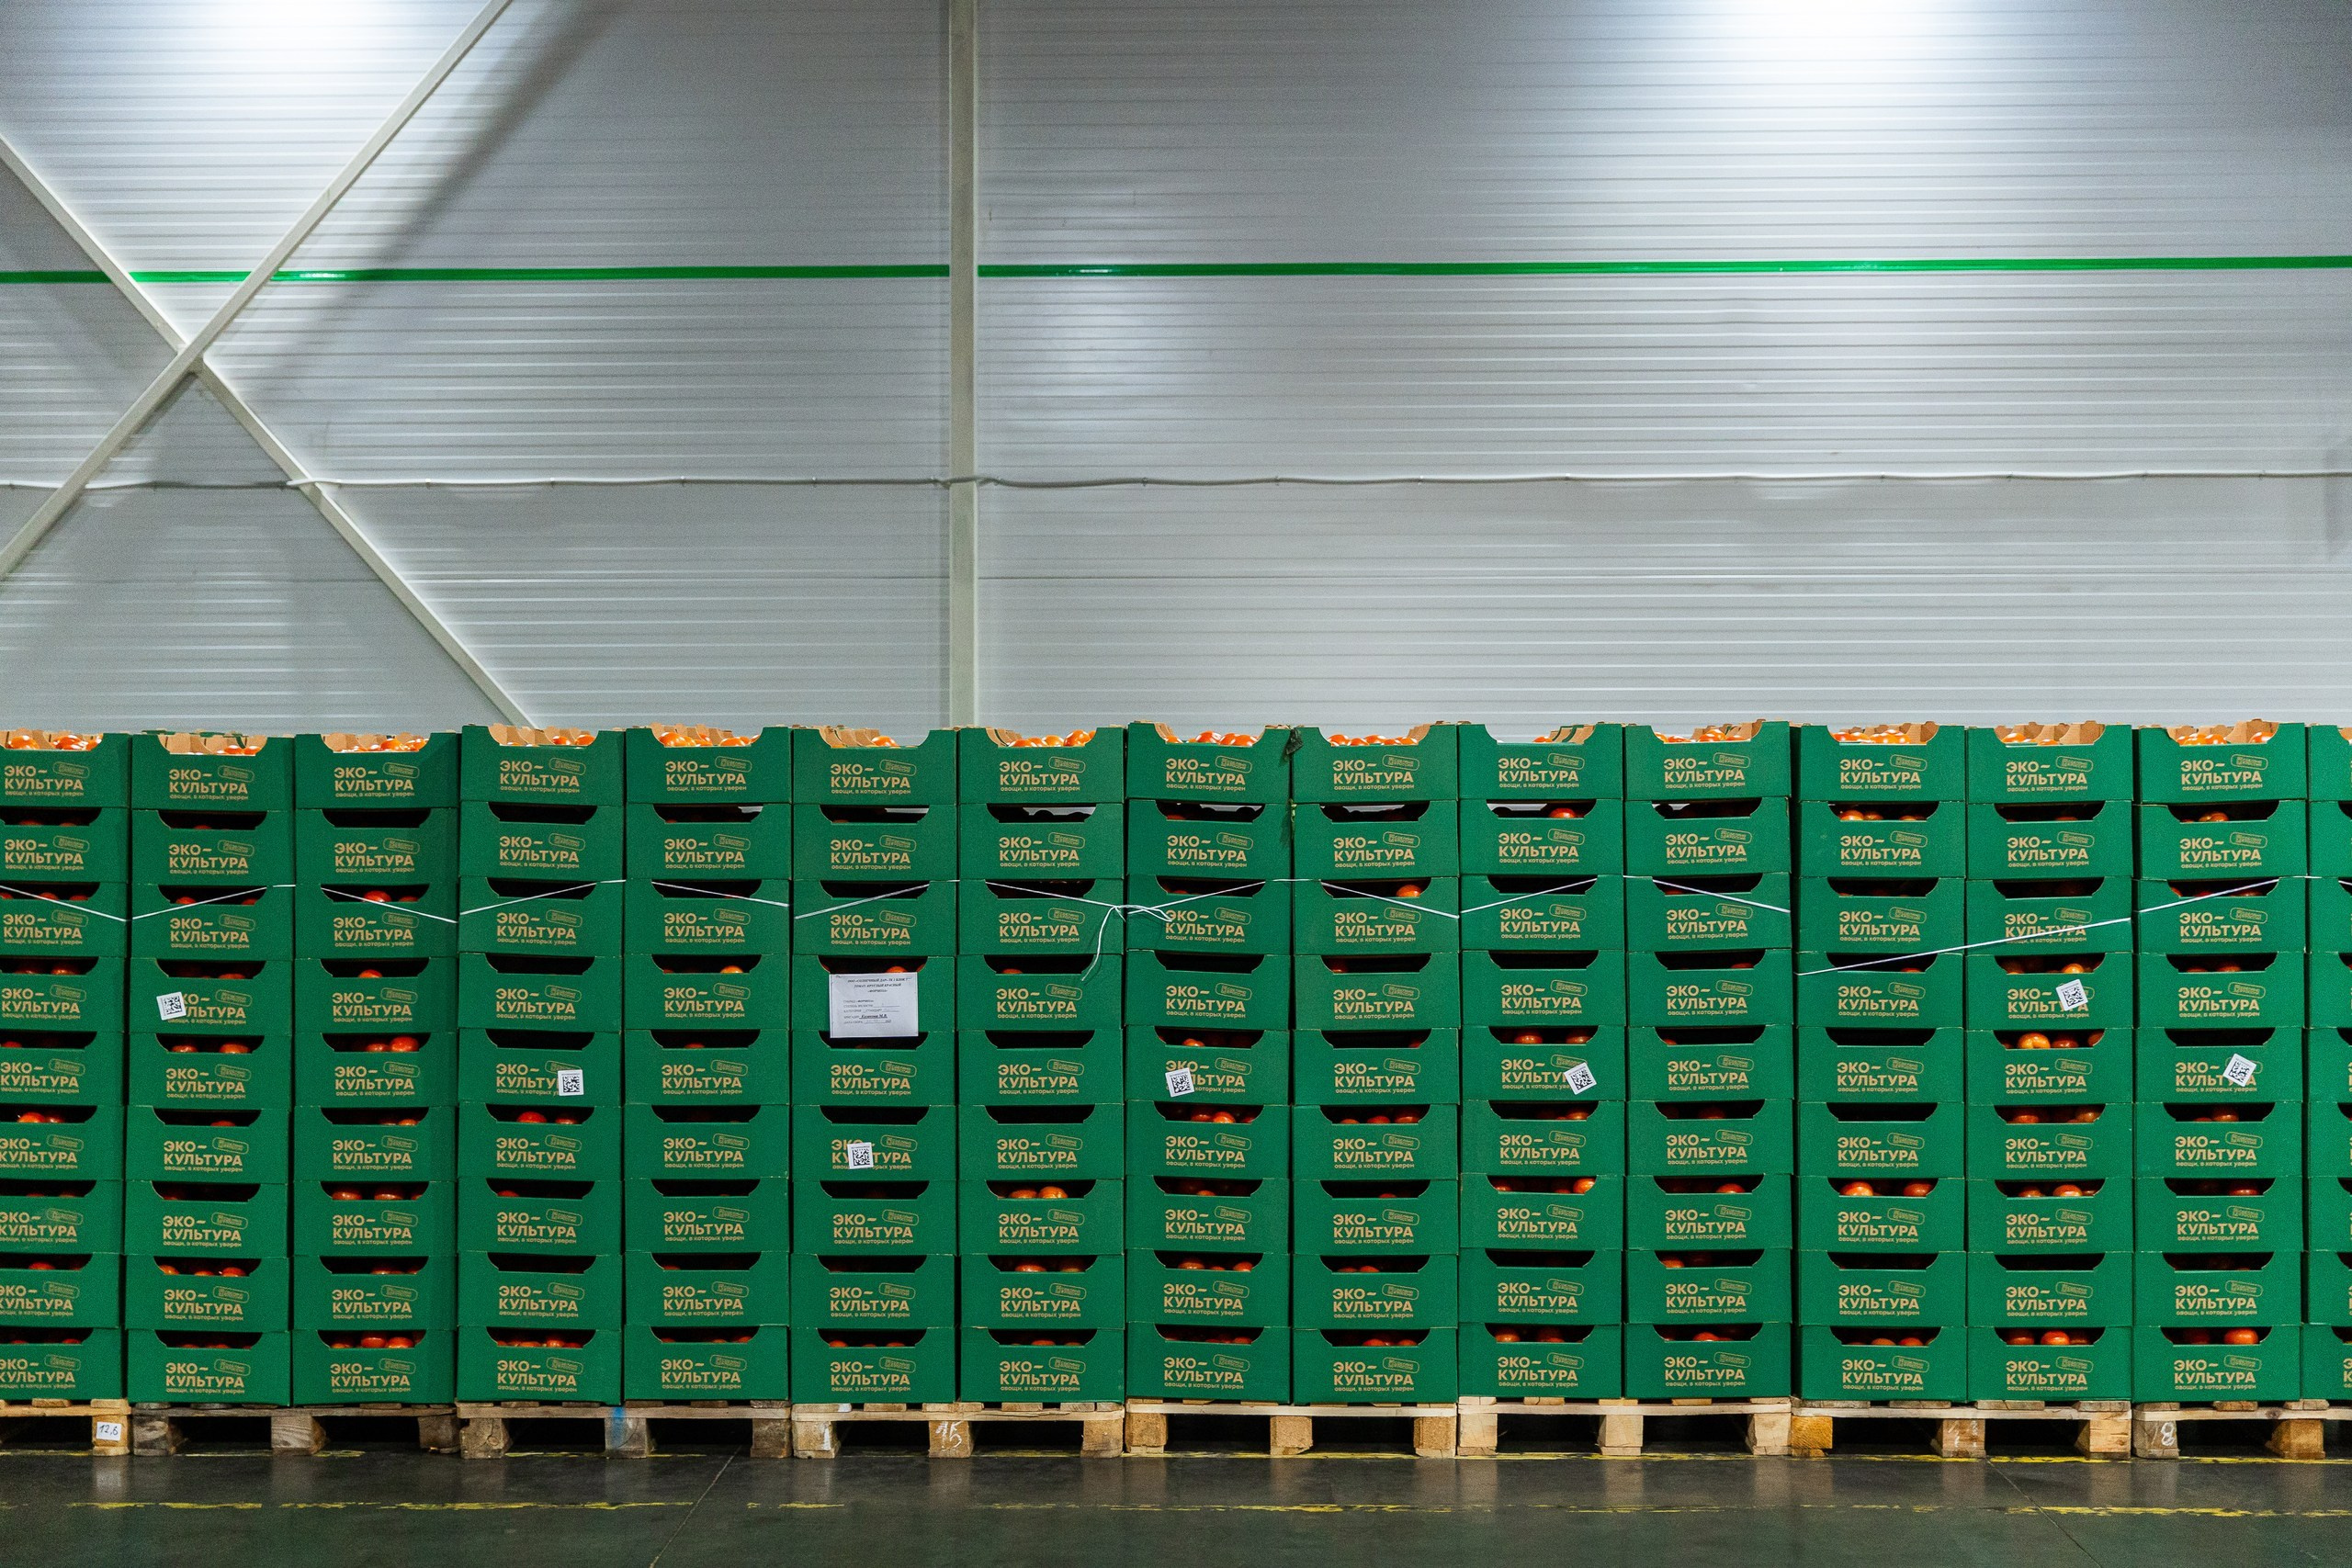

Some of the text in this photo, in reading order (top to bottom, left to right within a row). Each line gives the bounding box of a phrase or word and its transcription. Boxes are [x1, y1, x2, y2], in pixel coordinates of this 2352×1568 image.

[665, 760, 710, 772] ЭКО-
[999, 761, 1044, 773] ЭКО-
[1333, 759, 1378, 771] ЭКО-
[1664, 757, 1709, 769] ЭКО-
[2007, 761, 2052, 773] ЭКО-
[5, 765, 49, 777] ЭКО-
[334, 766, 379, 778] ЭКО-
[1664, 770, 1745, 782] КУЛЬТУРА
[5, 778, 85, 790] КУЛЬТУРА
[665, 773, 746, 784] КУЛЬТУРА
[999, 773, 1080, 785] КУЛЬТУРА
[1333, 772, 1414, 784] КУЛЬТУРА
[2007, 773, 2087, 785] КУЛЬТУРА
[334, 779, 414, 791] КУЛЬТУРА
[500, 836, 544, 848] ЭКО-
[1167, 835, 1212, 847] ЭКО-
[1498, 832, 1544, 844] ЭКО-
[1840, 835, 1885, 847] ЭКО-
[2180, 837, 2225, 849] ЭКО-
[169, 843, 213, 855] ЭКО-
[830, 839, 875, 851] ЭКО-
[1498, 845, 1579, 857] КУЛЬТУРА
[500, 849, 580, 861] КУЛЬТУРА
[830, 852, 910, 863] КУЛЬТУРА
[1167, 848, 1248, 860] КУЛЬТУРА
[1840, 848, 1921, 860] КУЛЬТУРА
[2180, 850, 2261, 862] КУЛЬТУРА
[169, 856, 249, 868] КУЛЬТУРА
[4, 913, 48, 925] ЭКО-
[664, 912, 709, 924] ЭКО-
[999, 912, 1044, 924] ЭКО-
[1334, 911, 1379, 923] ЭКО-
[1667, 908, 1712, 919] ЭКО-
[2005, 912, 2050, 924] ЭКО-
[334, 916, 378, 928] ЭКО-
[1667, 920, 1747, 932] КУЛЬТУРА
[4, 926, 84, 938] КУЛЬТУРА
[334, 929, 413, 941] КУЛЬТУРА
[664, 925, 745, 937] КУЛЬТУРА
[999, 925, 1080, 937] КУЛЬТУРА
[1334, 924, 1415, 936] КУЛЬТУРА
[496, 988, 540, 1000] ЭКО-
[1165, 986, 1210, 998] ЭКО-
[1501, 984, 1546, 996] ЭКО-
[1838, 986, 1883, 998] ЭКО-
[2178, 986, 2223, 998] ЭКО-
[182, 993, 210, 1005] КО-
[1165, 998, 1246, 1010] КУЛЬТУРА
[1501, 997, 1582, 1009] КУЛЬТУРА
[1838, 998, 1919, 1010] КУЛЬТУРА
[2178, 998, 2259, 1010] КУЛЬТУРА
[187, 1007, 246, 1018] ЛЬТУРА
[496, 1001, 576, 1013] КУЛЬТУРА
[335, 1065, 379, 1077] ЭКО-
[662, 1064, 707, 1076] ЭКО-
[998, 1063, 1043, 1075] ЭКО-
[1334, 1062, 1379, 1074] ЭКО-
[1668, 1059, 1713, 1071] ЭКО-
[2006, 1063, 2051, 1075] ЭКО-
[0, 1075, 79, 1088] КУЛЬТУРА
[335, 1077, 415, 1089] КУЛЬТУРА
[662, 1077, 742, 1089] КУЛЬТУРА
[998, 1076, 1079, 1088] КУЛЬТУРА
[1334, 1075, 1415, 1087] КУЛЬТУРА
[1668, 1072, 1748, 1084] КУЛЬТУРА
[2006, 1076, 2086, 1088] КУЛЬТУРА
[496, 1137, 540, 1149] ЭКО-
[1165, 1136, 1210, 1148] ЭКО-
[1499, 1134, 1544, 1146] ЭКО-
[1838, 1136, 1883, 1148] ЭКО-
[2176, 1135, 2221, 1147] ЭКО-
[164, 1141, 208, 1153] ЭКО-
[1499, 1147, 1580, 1159] КУЛЬТУРА
[164, 1154, 243, 1166] КУЛЬТУРА
[496, 1150, 576, 1162] КУЛЬТУРА
[1165, 1149, 1246, 1161] КУЛЬТУРА
[1838, 1149, 1918, 1161] КУЛЬТУРА
[2176, 1148, 2256, 1160] КУЛЬТУРА
[333, 1213, 377, 1225] ЭКО-
[663, 1211, 708, 1223] ЭКО-
[998, 1213, 1043, 1224] ЭКО-
[1333, 1213, 1378, 1225] ЭКО-
[1665, 1209, 1710, 1221] ЭКО-
[2006, 1213, 2051, 1224] ЭКО-
[333, 1226, 413, 1238] КУЛЬТУРА
[663, 1224, 744, 1235] КУЛЬТУРА
[998, 1225, 1079, 1237] КУЛЬТУРА
[1333, 1226, 1414, 1238] КУЛЬТУРА
[1665, 1222, 1746, 1234] КУЛЬТУРА
[2006, 1225, 2086, 1237] КУЛЬТУРА
[499, 1285, 543, 1297] ЭКО-
[830, 1286, 875, 1298] ЭКО-
[1163, 1283, 1208, 1295] ЭКО-
[1497, 1282, 1542, 1294] ЭКО-
[1838, 1284, 1883, 1296] ЭКО-
[2176, 1284, 2221, 1296] ЭКО-
[164, 1289, 209, 1301] ЭКО-
[1497, 1295, 1577, 1307] КУЛЬТУРА
[164, 1302, 244, 1314] КУЛЬТУРА
[499, 1298, 579, 1310] КУЛЬТУРА
[830, 1299, 910, 1311] КУЛЬТУРА
[1163, 1296, 1244, 1308] КУЛЬТУРА
[1838, 1297, 1919, 1309] КУЛЬТУРА
[2176, 1297, 2256, 1309] КУЛЬТУРА
[331, 1362, 375, 1374] ЭКО-
[661, 1359, 706, 1371] ЭКО-
[1000, 1360, 1045, 1372] ЭКО-
[1333, 1360, 1378, 1372] ЭКО-
[1665, 1356, 1710, 1368] ЭКО-
[2007, 1360, 2052, 1372] ЭКО-
[331, 1375, 411, 1387] КУЛЬТУРА
[661, 1371, 741, 1383] КУЛЬТУРА
[1000, 1373, 1080, 1385] КУЛЬТУРА
[1333, 1373, 1414, 1385] КУЛЬТУРА
[1665, 1369, 1746, 1381] КУЛЬТУРА
[2007, 1373, 2087, 1385] КУЛЬТУРА
[99, 1424, 119, 1436] 12,6
